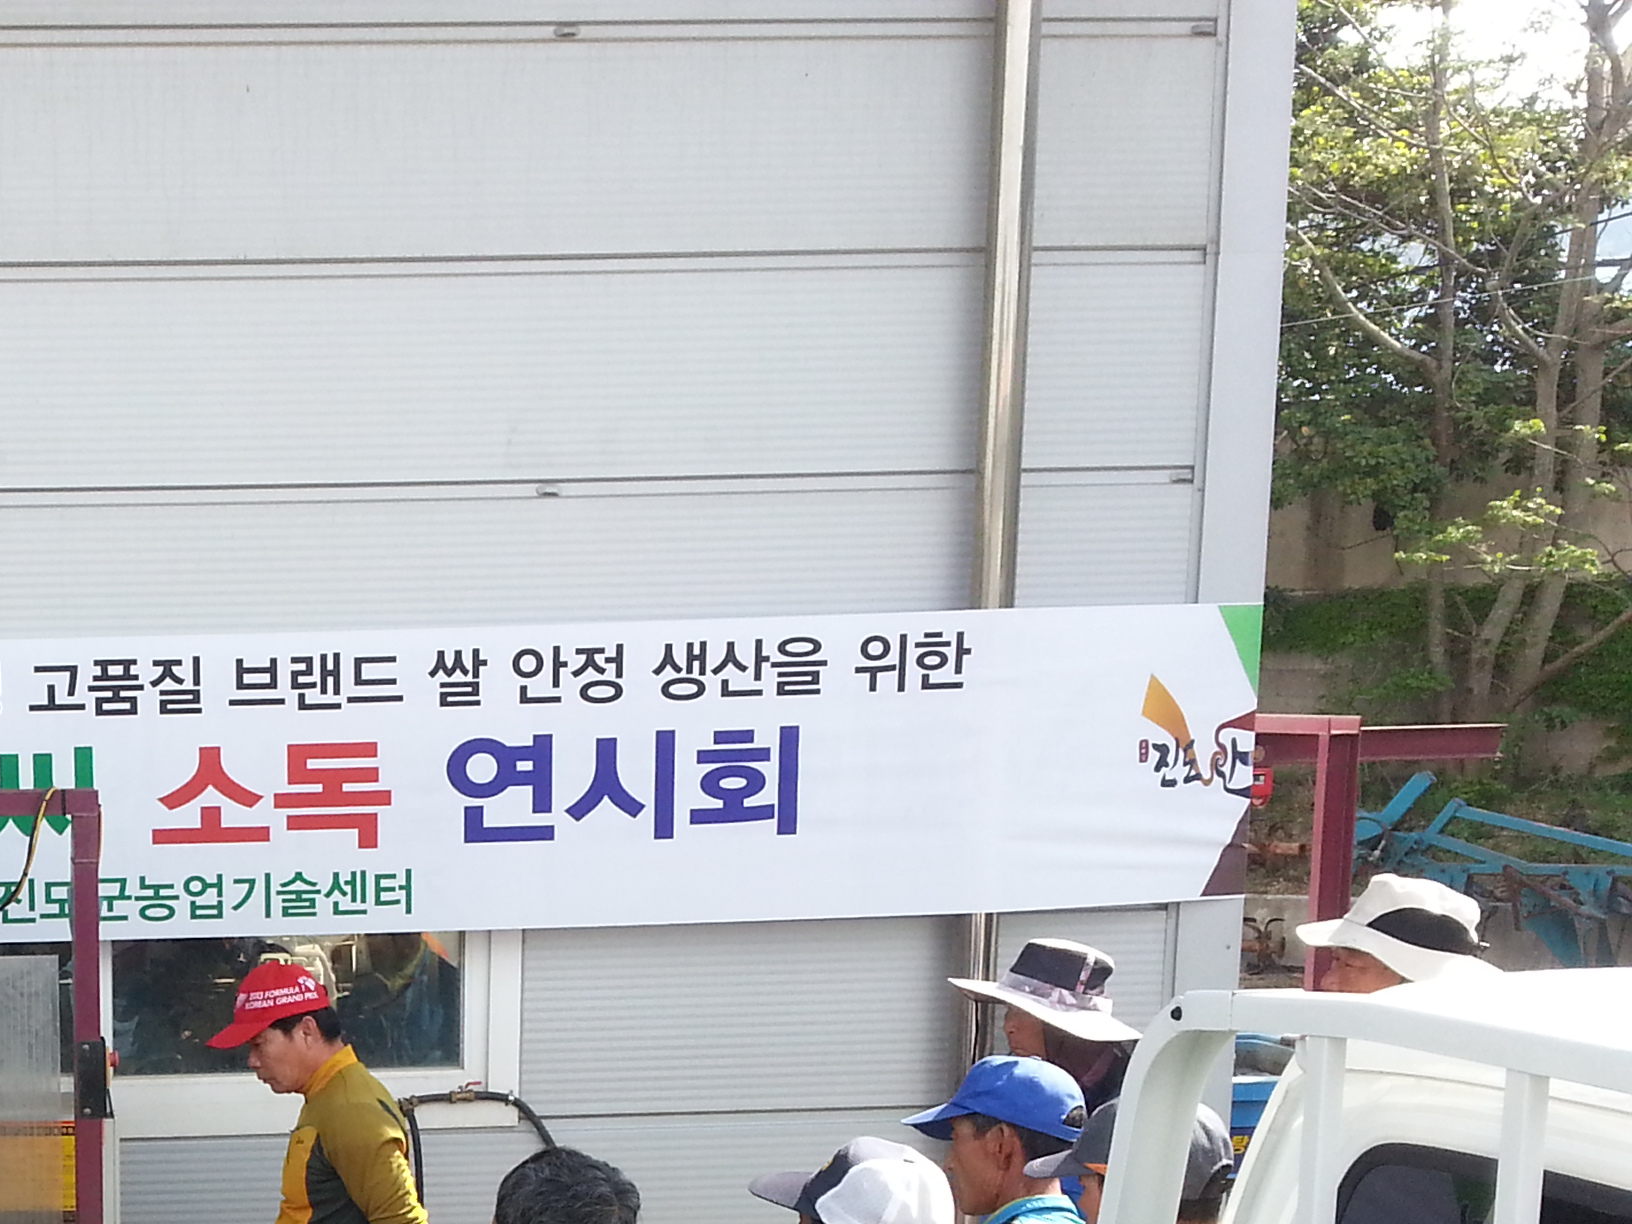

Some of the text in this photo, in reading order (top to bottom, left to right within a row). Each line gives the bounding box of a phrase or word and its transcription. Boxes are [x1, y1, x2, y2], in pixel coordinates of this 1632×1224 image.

[29, 656, 202, 716] 고품질
[229, 653, 403, 710] 브랜드
[429, 649, 487, 707] 쌀
[513, 644, 623, 704] 안정
[652, 637, 827, 700] 생산을
[855, 632, 971, 692] 위한
[153, 743, 392, 848] 소독
[448, 727, 799, 842] 연시회
[264, 985, 301, 999] FORMULA
